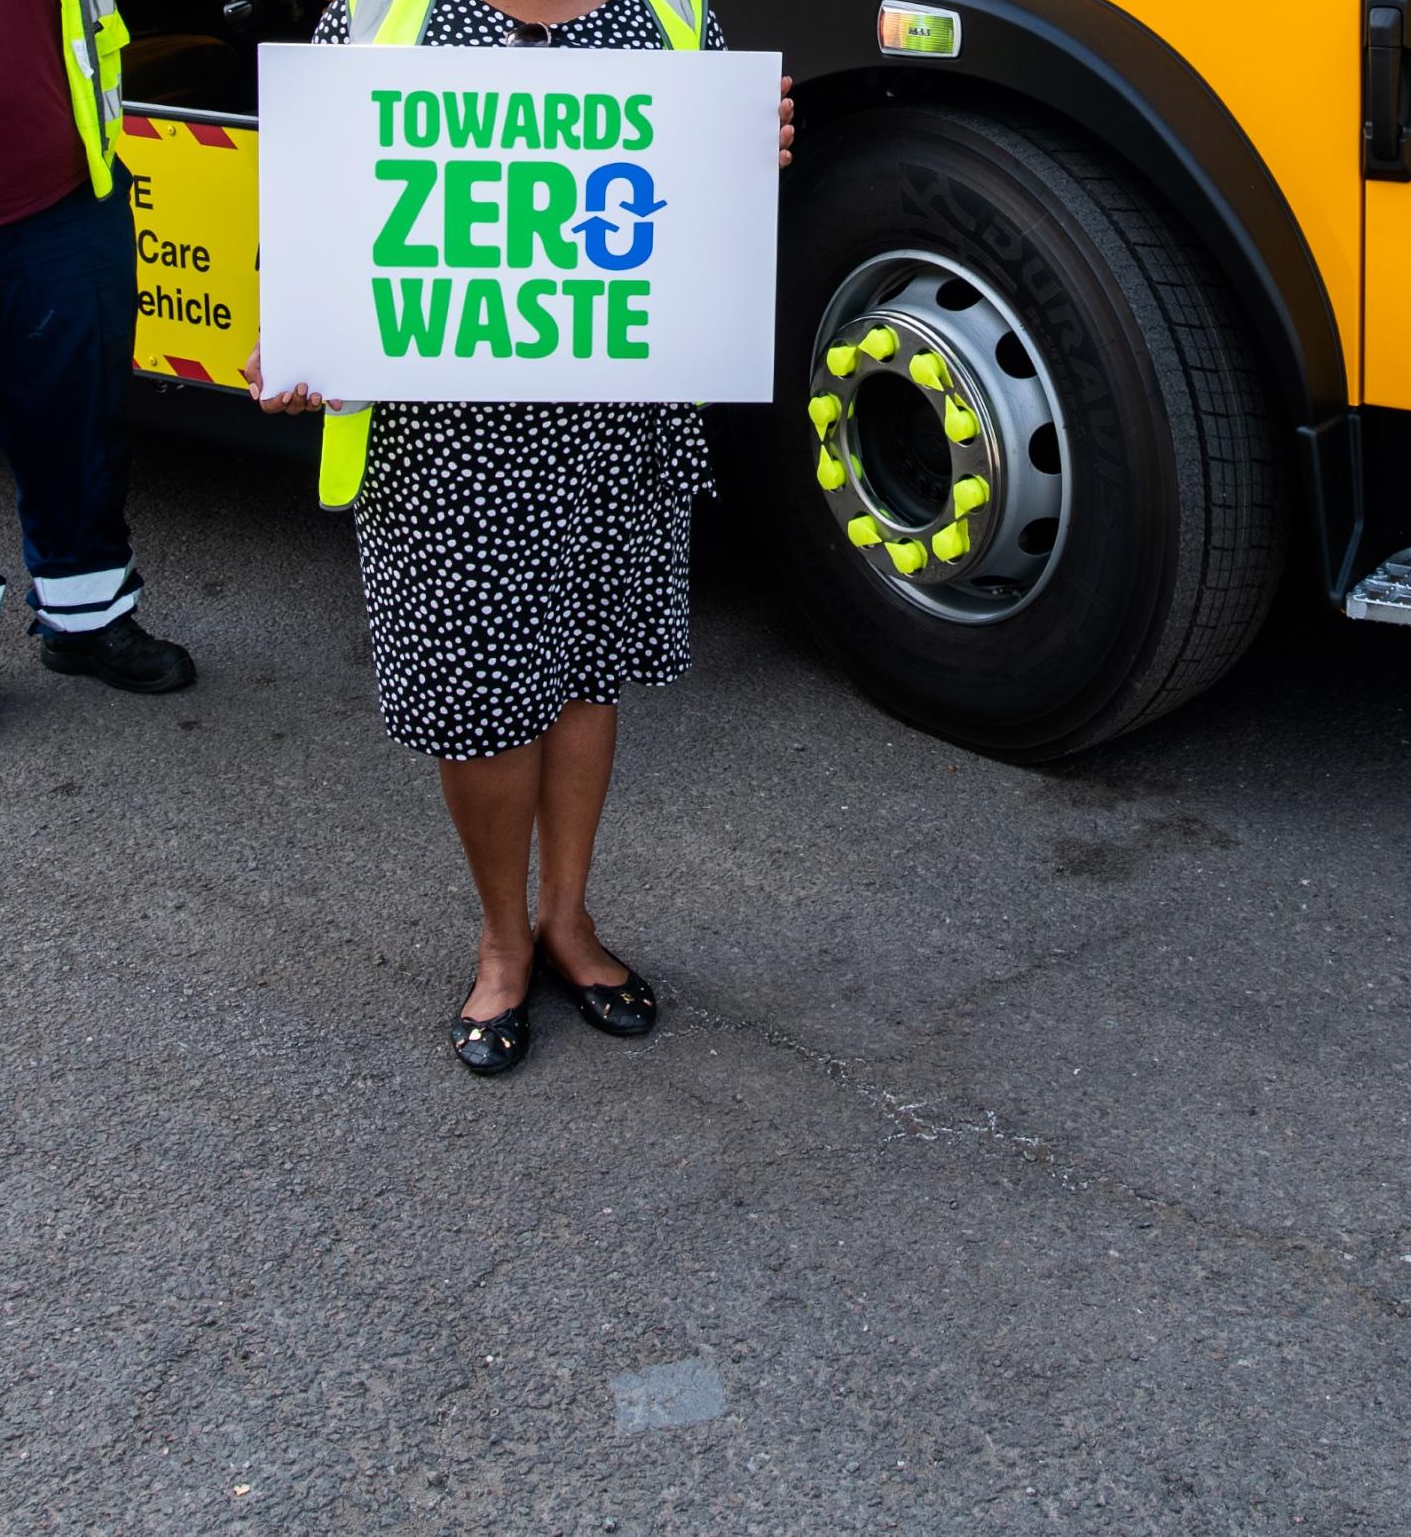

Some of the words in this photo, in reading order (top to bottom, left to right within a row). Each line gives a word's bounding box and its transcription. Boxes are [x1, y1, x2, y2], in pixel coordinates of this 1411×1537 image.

[372, 90, 654, 151] TOWARDS
[372, 160, 669, 271] ZERO
[138, 229, 210, 273] Care
[138, 285, 231, 330] ehicle
[372, 278, 650, 360] WASTE
